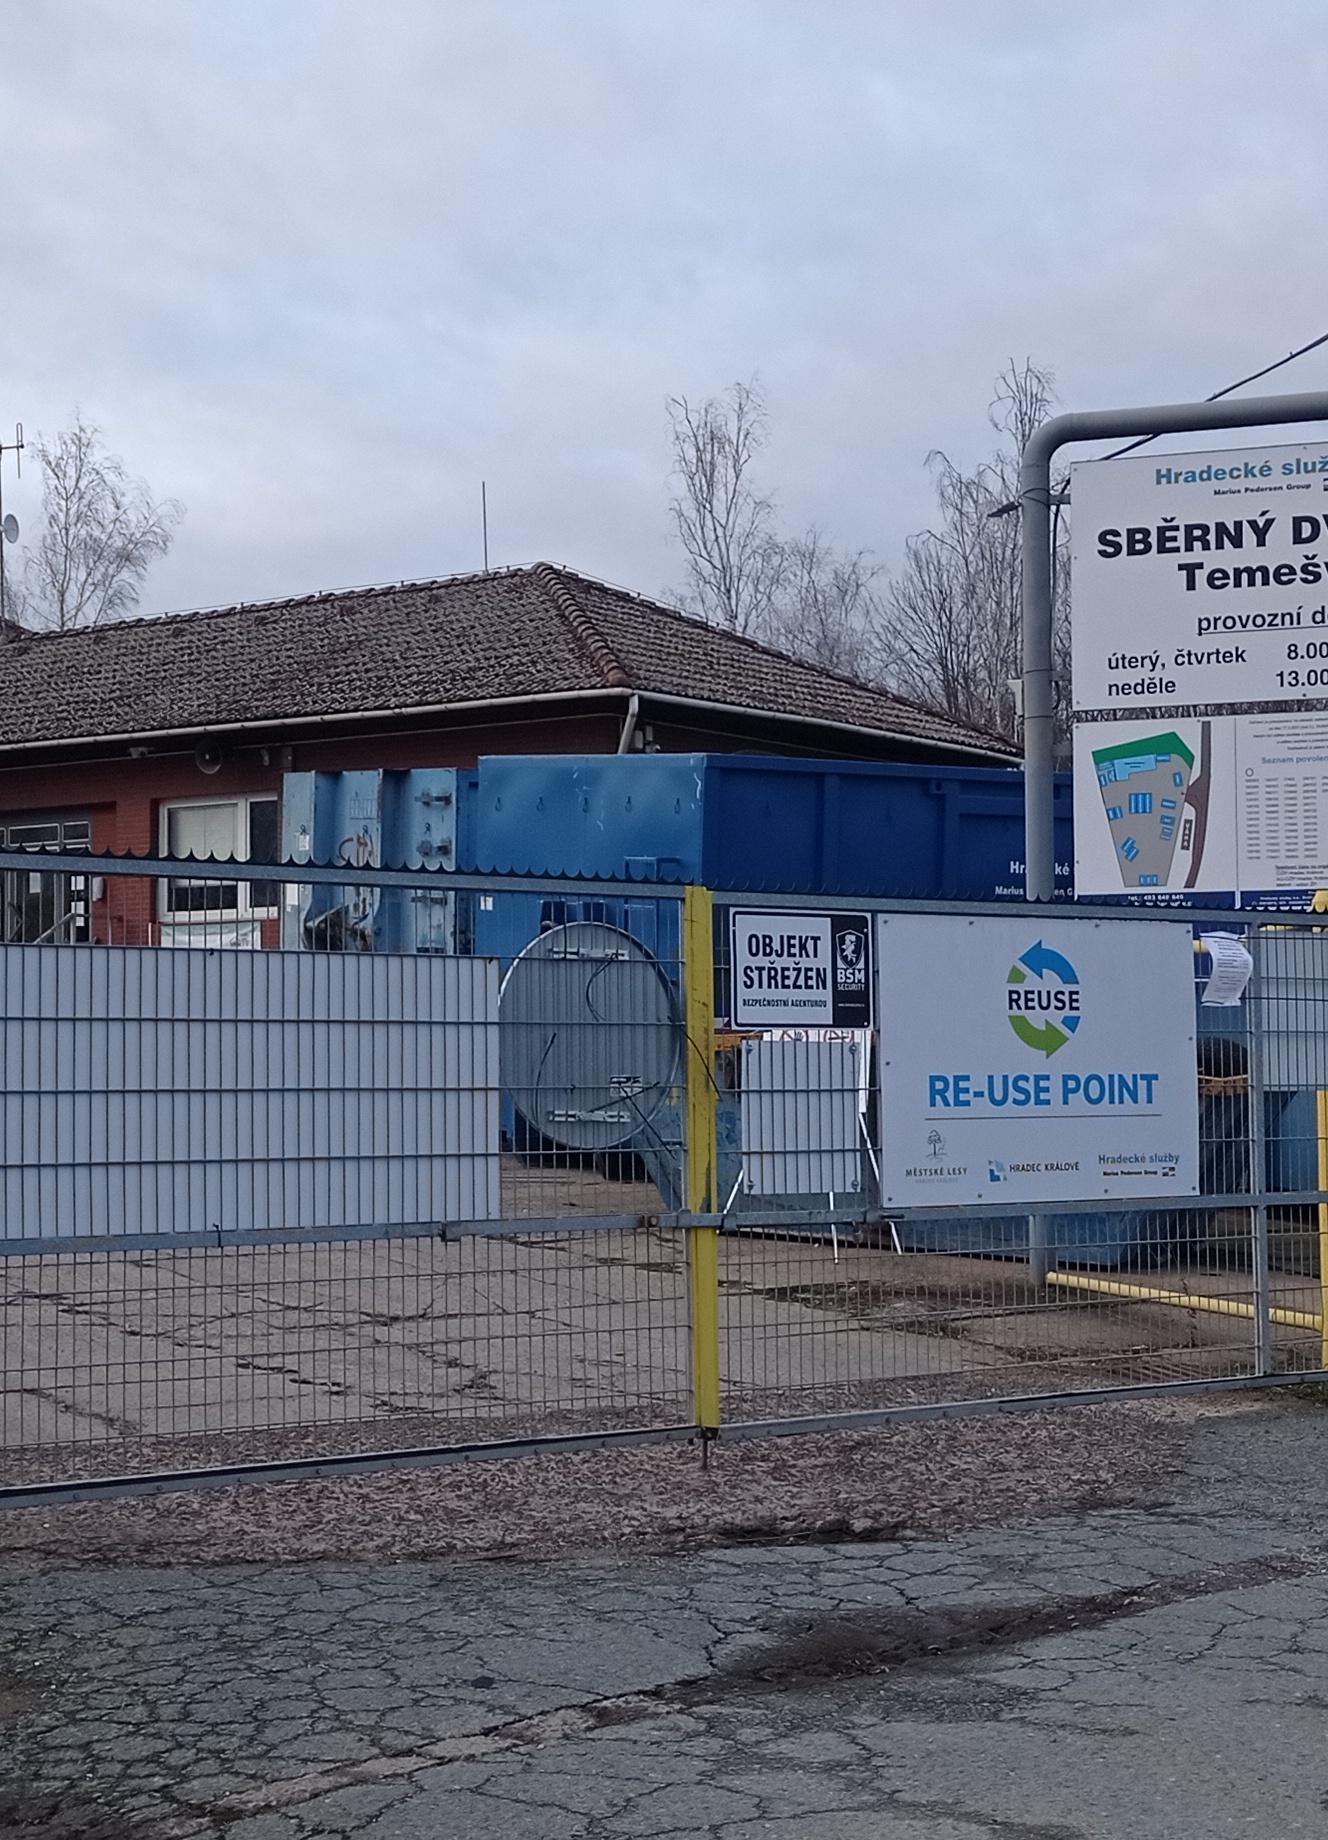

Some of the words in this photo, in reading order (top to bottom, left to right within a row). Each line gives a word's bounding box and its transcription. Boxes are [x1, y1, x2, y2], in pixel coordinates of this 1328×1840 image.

[1155, 460, 1273, 485] Hradecké
[1213, 487, 1241, 496] Marius
[1244, 485, 1283, 494] Pedersen
[1286, 482, 1312, 491] Group
[1097, 510, 1276, 558] SBĚRNÝ
[1197, 605, 1302, 636] provozní
[1108, 650, 1166, 672] úterý,
[1174, 646, 1247, 666] čtvrtek
[1108, 676, 1176, 696] neděle
[1261, 756, 1294, 765] Seznam
[1010, 860, 1070, 875] Hrké
[995, 886, 1024, 895] Marius
[747, 933, 821, 958] OBJEKT
[743, 960, 827, 990] STŘEŽEN
[837, 969, 865, 983] BSM
[837, 983, 865, 991] SECURITY
[742, 997, 790, 1008] BEZPEČNOSTNÍ
[790, 999, 827, 1008] AGENTUROU
[1008, 989, 1080, 1011] REUSE
[928, 1073, 1052, 1108] RE-USE
[1062, 1073, 1160, 1106] POINT
[1009, 1162, 1042, 1173] HRADEC
[1044, 1160, 1080, 1172] KRÁLOVÉ
[1098, 1153, 1147, 1165] Hradecké
[1149, 1153, 1180, 1165] služby
[905, 1167, 944, 1177] MĚSTSKÉ
[947, 1167, 968, 1176] LESY
